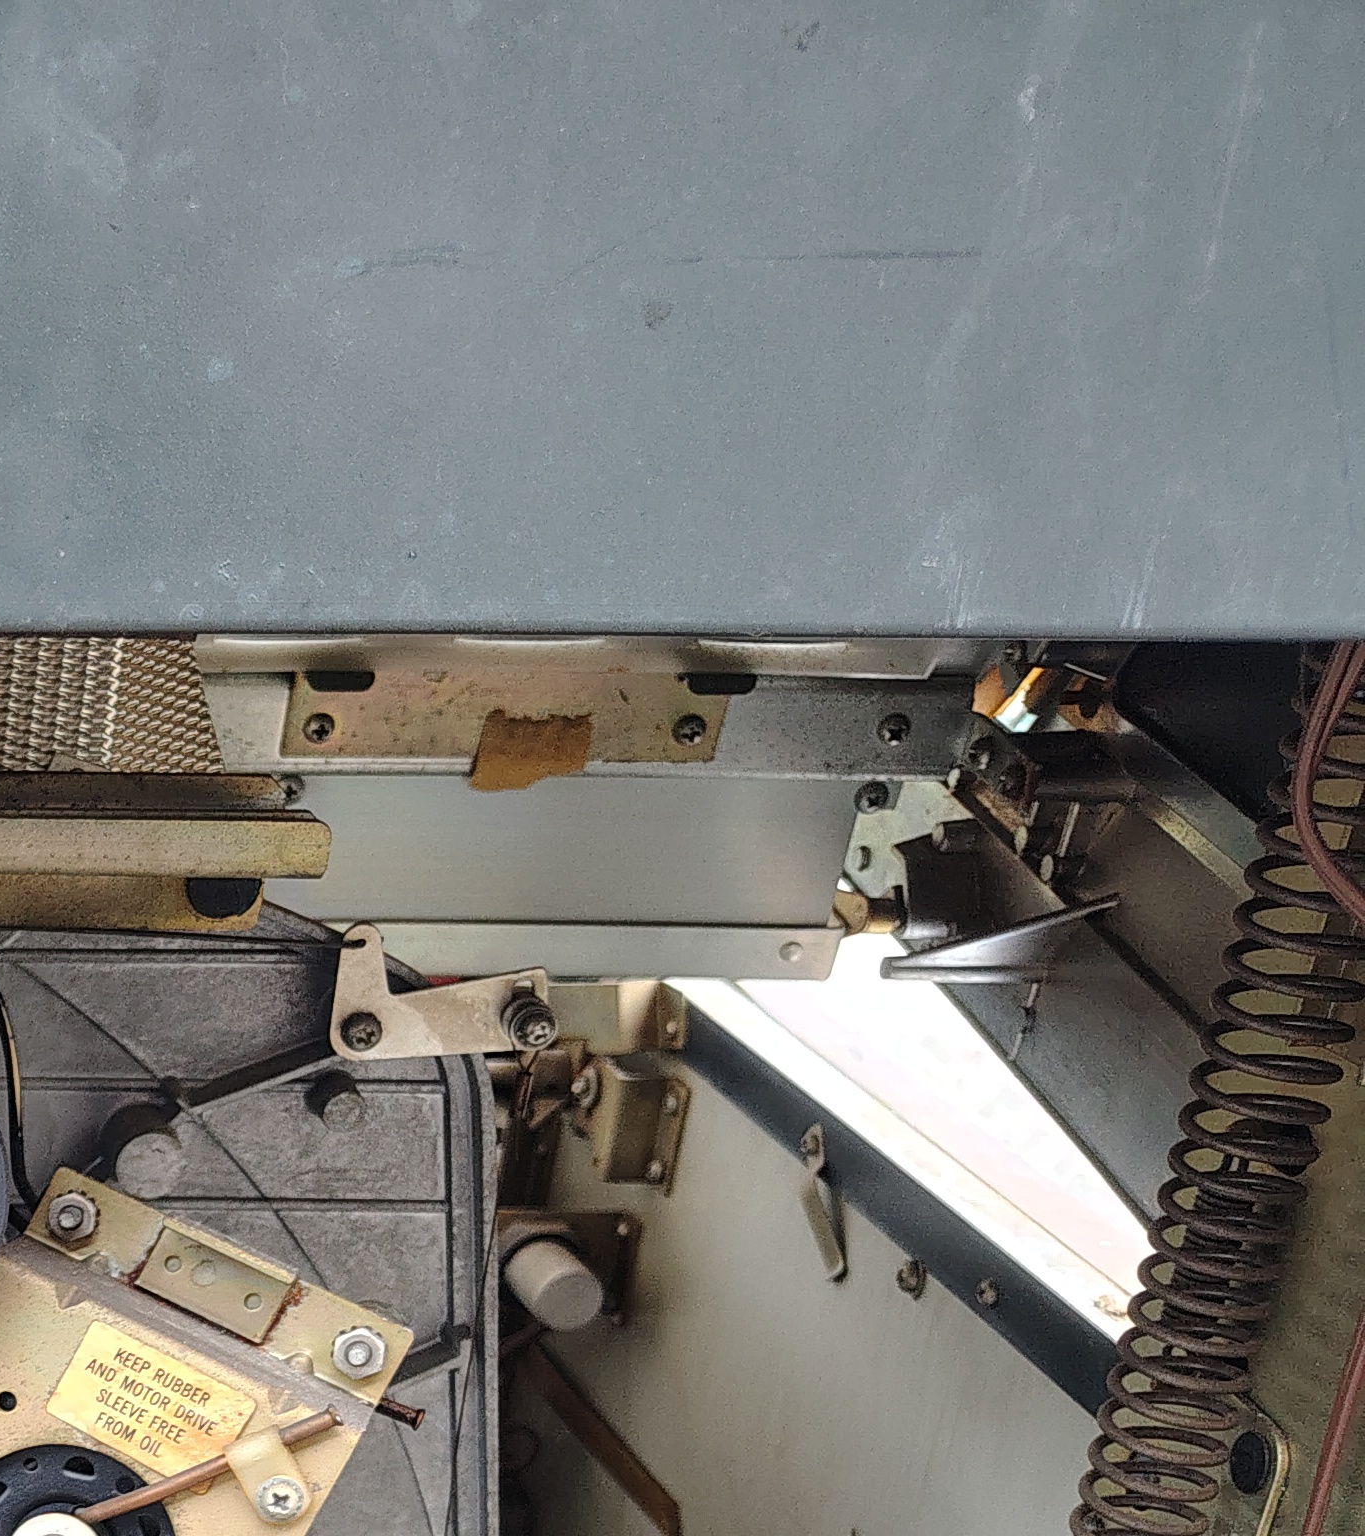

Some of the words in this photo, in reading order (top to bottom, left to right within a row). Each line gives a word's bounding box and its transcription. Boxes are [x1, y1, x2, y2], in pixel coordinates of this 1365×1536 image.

[85, 1359, 116, 1382] AND
[120, 1376, 172, 1411] MOTOR
[174, 1404, 218, 1437] DRIVE
[113, 1348, 152, 1374] KEEP
[152, 1368, 211, 1407] RUBBER
[95, 1412, 136, 1443] FROM
[139, 1435, 162, 1459] OIL
[96, 1389, 149, 1424] SLEEVE
[149, 1416, 186, 1445] FREE
